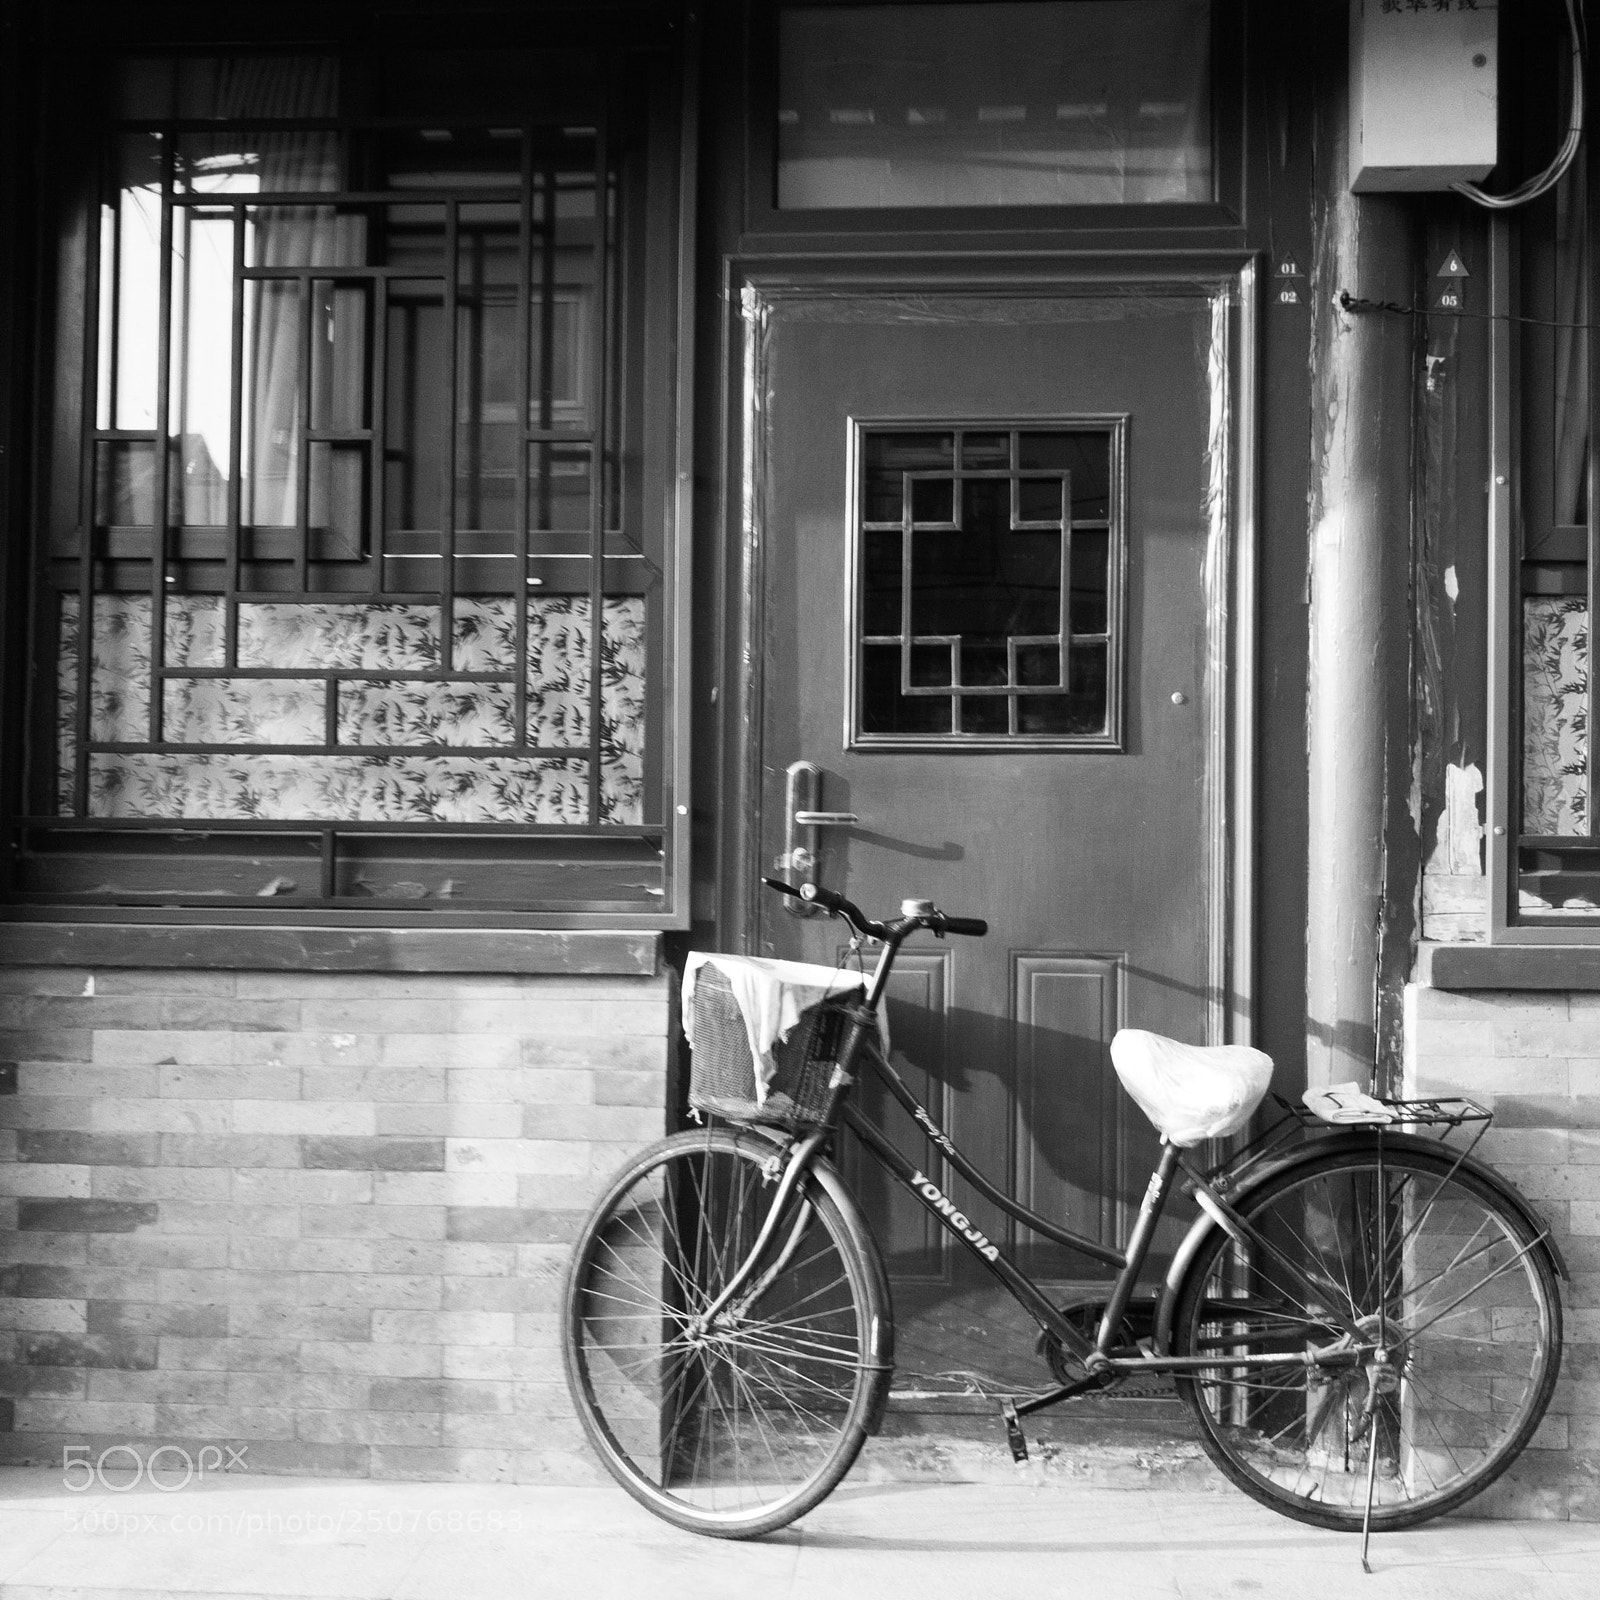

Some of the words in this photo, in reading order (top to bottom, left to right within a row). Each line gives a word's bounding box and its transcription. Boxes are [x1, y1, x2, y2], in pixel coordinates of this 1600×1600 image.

[1281, 262, 1297, 275] 01
[1449, 262, 1458, 272] 6
[1280, 291, 1297, 303] 02
[1441, 295, 1458, 307] 05
[911, 1170, 999, 1262] YONGJIA
